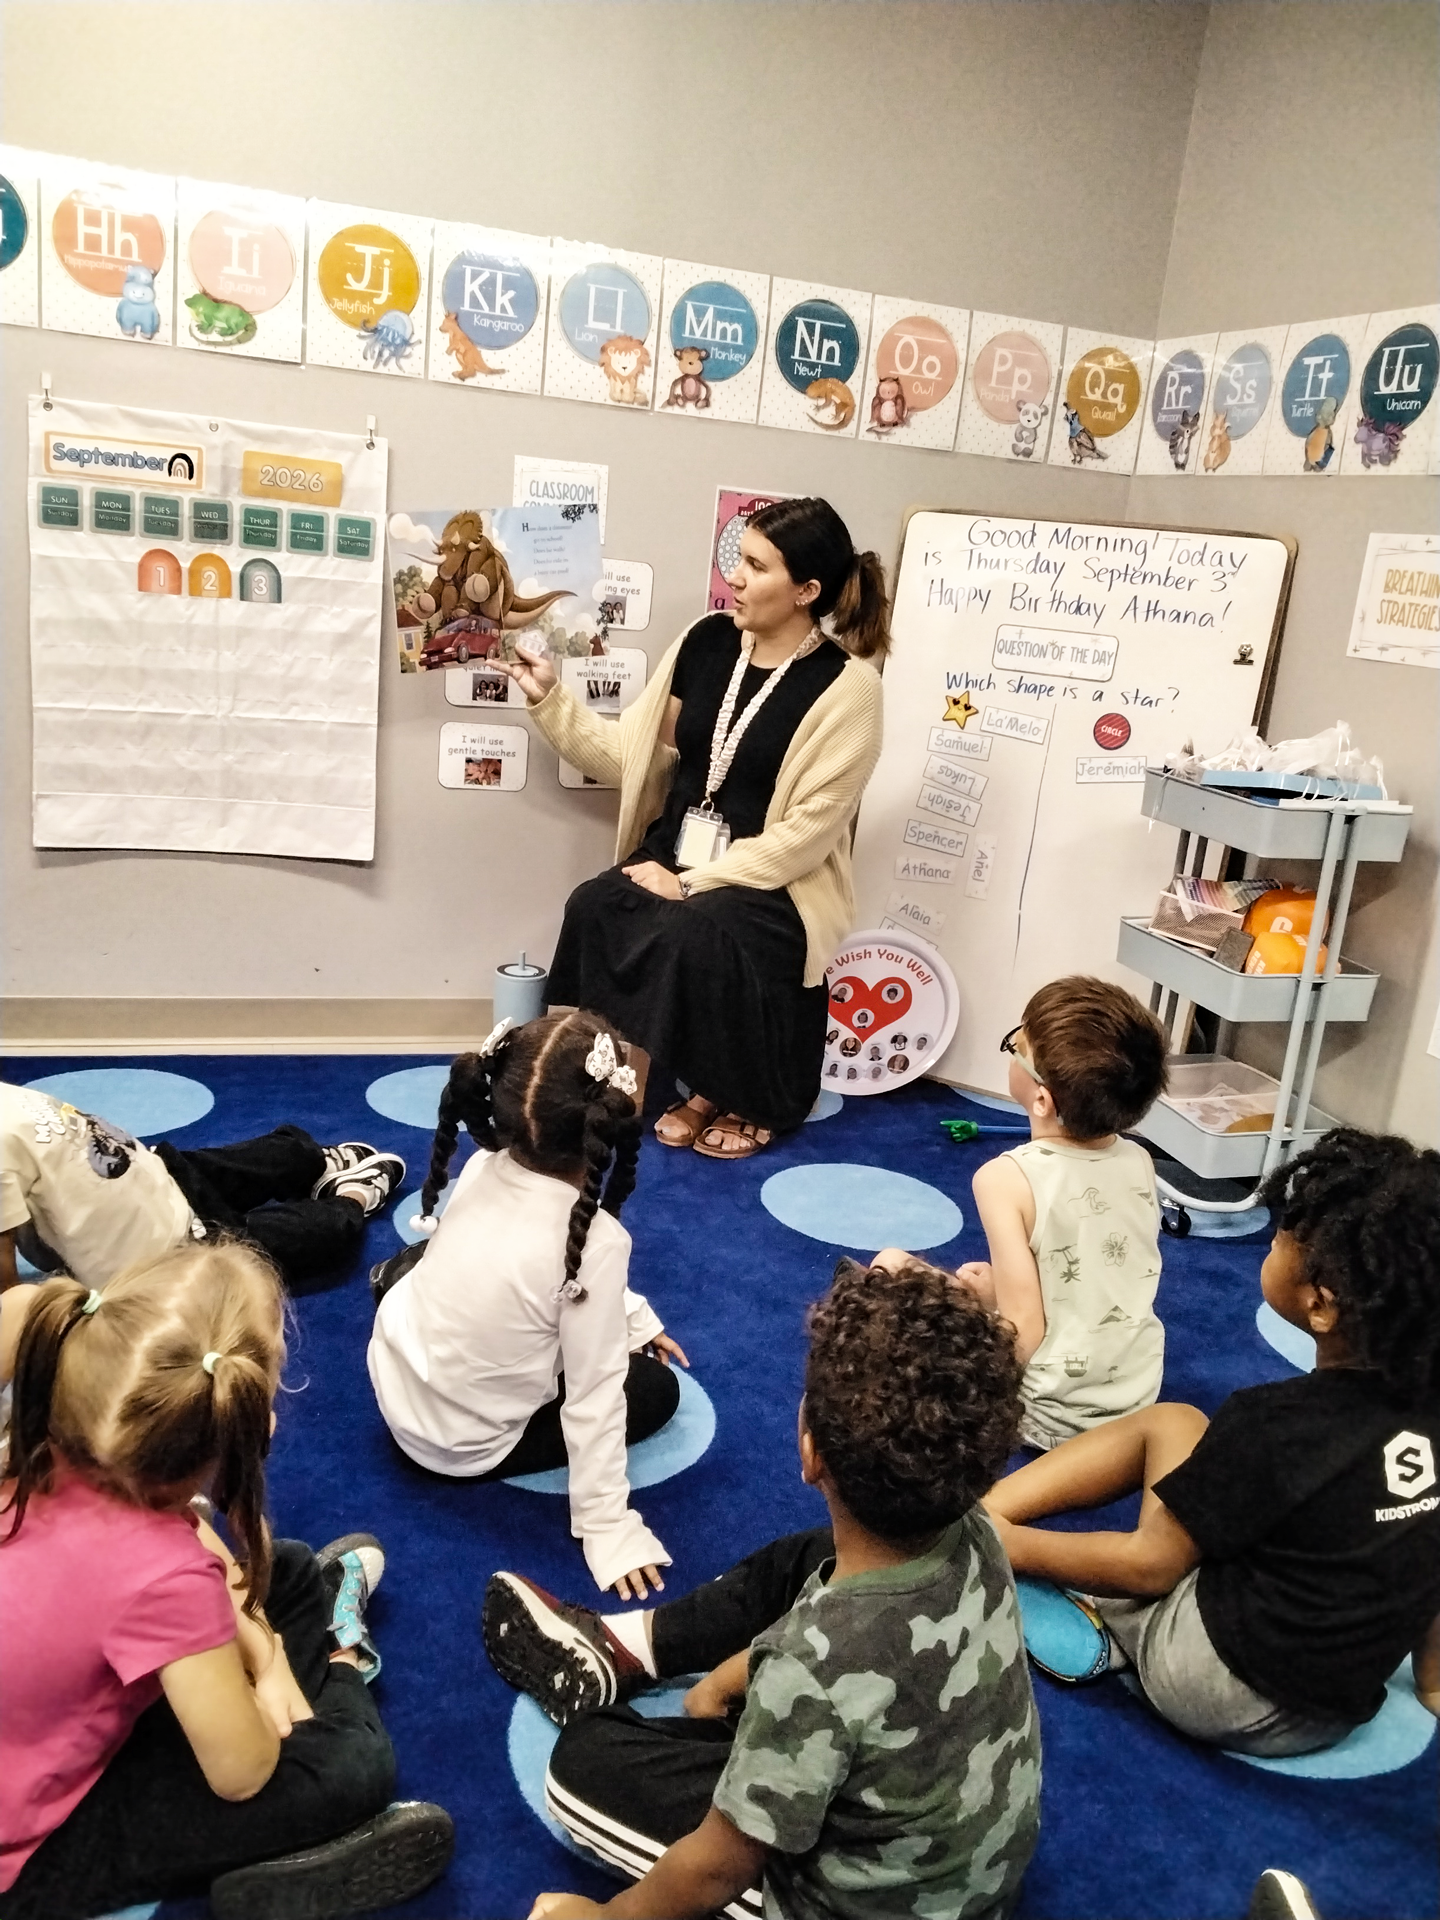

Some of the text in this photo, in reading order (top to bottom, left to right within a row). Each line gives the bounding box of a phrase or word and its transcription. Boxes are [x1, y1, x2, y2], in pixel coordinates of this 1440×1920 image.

[77, 204, 140, 261] Hh
[222, 226, 261, 278] Ii
[218, 275, 266, 297] Iguana
[346, 246, 392, 304] Jj
[462, 267, 516, 317] Kk
[329, 296, 376, 316] Jellyfish
[587, 285, 623, 332] Ll
[473, 314, 525, 333] Kangaroo
[684, 304, 744, 345] Mm
[574, 327, 598, 344] Lion
[793, 318, 840, 366] Nn
[709, 346, 747, 365] Monkey
[894, 334, 942, 380] Oo
[794, 363, 823, 379] Newt
[989, 350, 1033, 399] Pp
[1301, 356, 1335, 401] Tt
[1377, 347, 1424, 394] Uu
[912, 380, 935, 398] Owl
[1083, 364, 1128, 413] Qq
[1163, 371, 1192, 409] Rr
[1226, 365, 1258, 404] Ss
[1091, 405, 1117, 421] Quail
[1291, 404, 1315, 418] Turtle
[1386, 397, 1422, 412] Unicorn
[51, 442, 168, 472] September
[259, 464, 325, 494] 2026
[50, 495, 68, 504] SUN
[529, 479, 595, 503] CLASSROOM
[101, 500, 123, 509] MON
[151, 505, 171, 515] TUES
[200, 510, 219, 519] WED
[249, 516, 271, 526] THUR
[300, 521, 314, 530] FRI
[346, 526, 360, 535] SAT
[967, 518, 1248, 573] Good Morning! Today
[154, 566, 165, 588] 1
[604, 571, 613, 580] ill
[924, 541, 942, 567] is
[960, 548, 1066, 591] Thursday
[1082, 556, 1200, 593] September
[202, 570, 219, 592] 2
[253, 574, 269, 596] 3
[620, 588, 641, 596] eyes
[1383, 568, 1440, 599] BREATHIN
[926, 578, 992, 614] Happy
[1008, 582, 1107, 628] Birthday
[996, 637, 1115, 667] QUESTION OF THE DAY
[592, 658, 607, 668] will
[610, 661, 625, 669] use
[576, 669, 632, 681] walking feet
[946, 671, 1181, 713] Which shape is a star?
[470, 735, 486, 745] will
[489, 738, 504, 746] use
[1101, 725, 1123, 737] CIRCLE
[448, 747, 516, 758] gentle touches
[934, 734, 985, 754] Samuel
[938, 764, 978, 795] Lukas
[1077, 762, 1145, 778] Jeremiah
[907, 826, 963, 851] Spencer
[901, 862, 951, 879] Athana
[835, 949, 872, 967] Wish
[877, 948, 904, 964] You
[906, 958, 933, 986] Well
[1375, 1496, 1440, 1522] KIDSTRON
